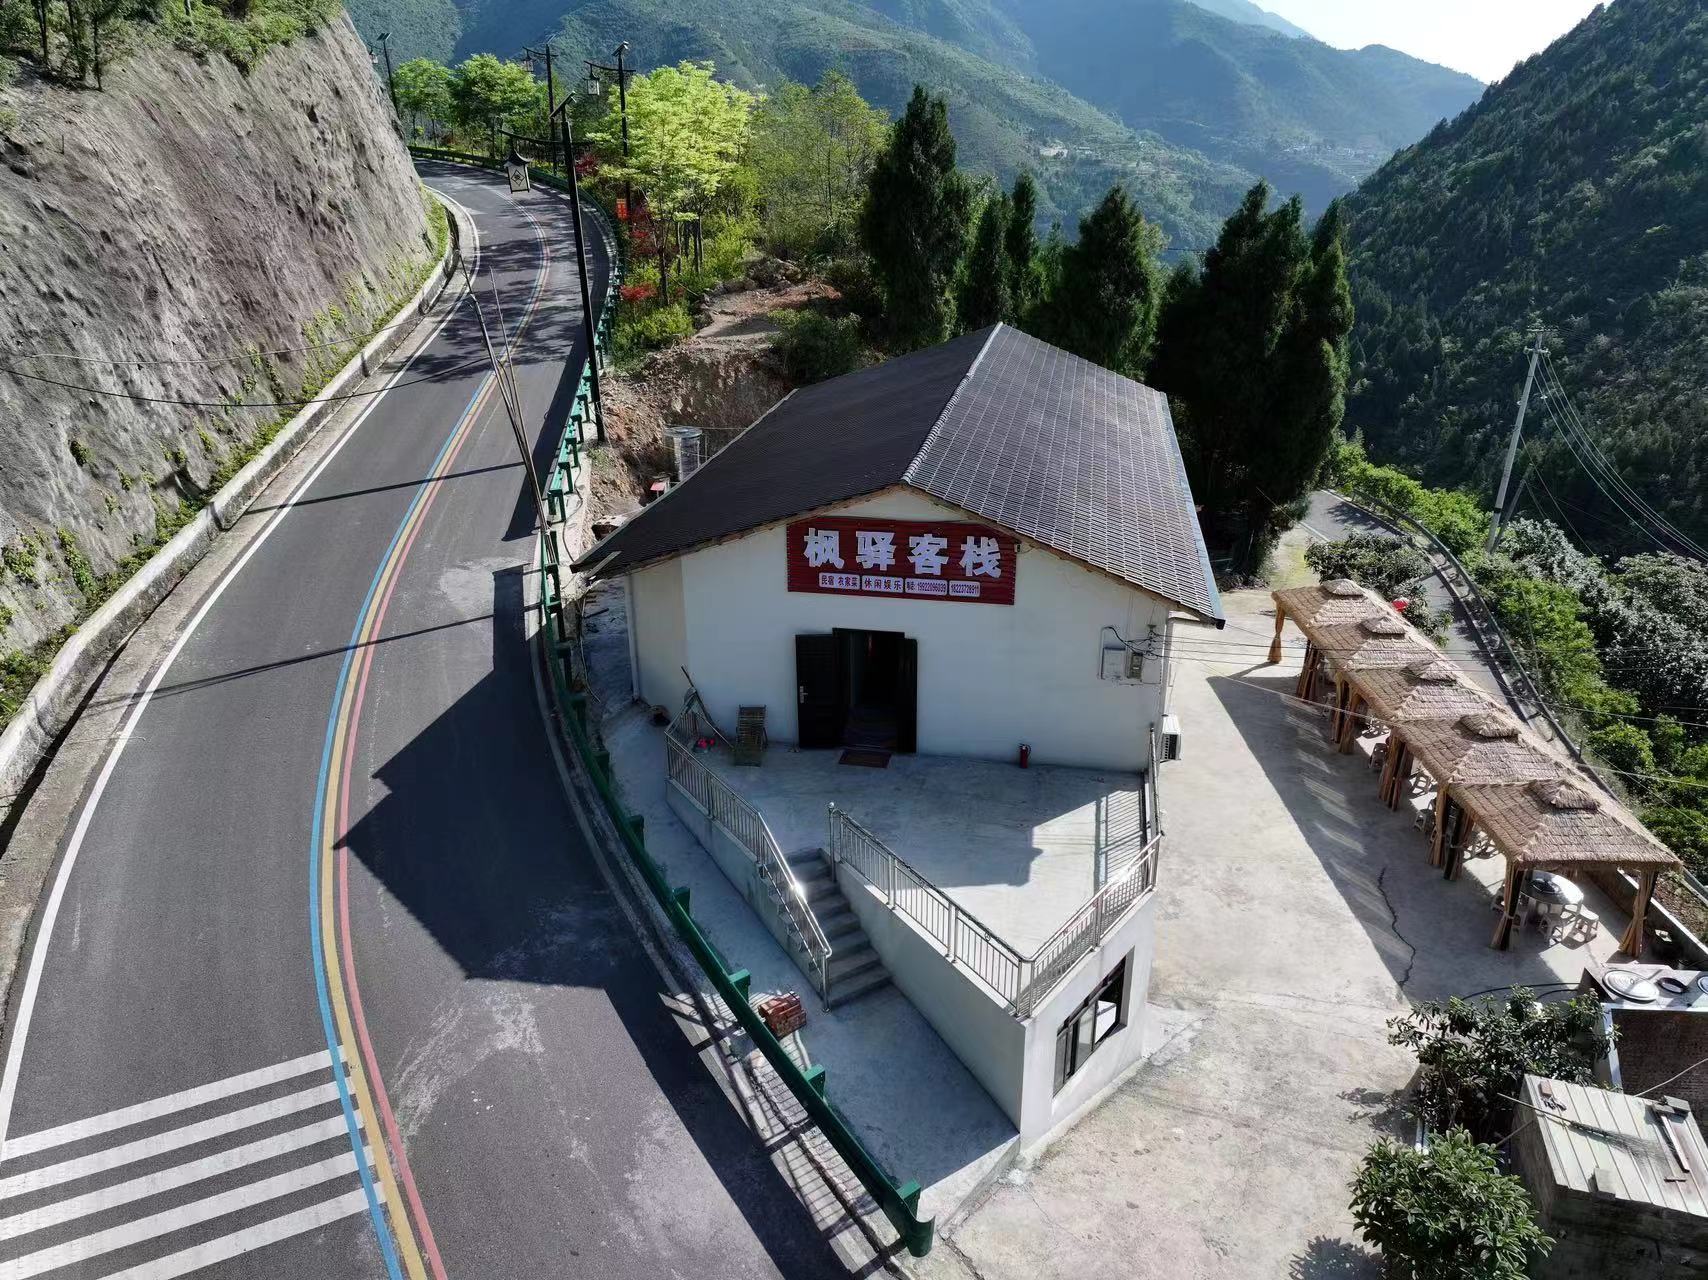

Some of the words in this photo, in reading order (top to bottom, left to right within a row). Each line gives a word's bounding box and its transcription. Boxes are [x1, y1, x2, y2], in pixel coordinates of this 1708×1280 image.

[804, 528, 1001, 578] 枫驿客栈
[864, 578, 902, 591] 休闲娱乐
